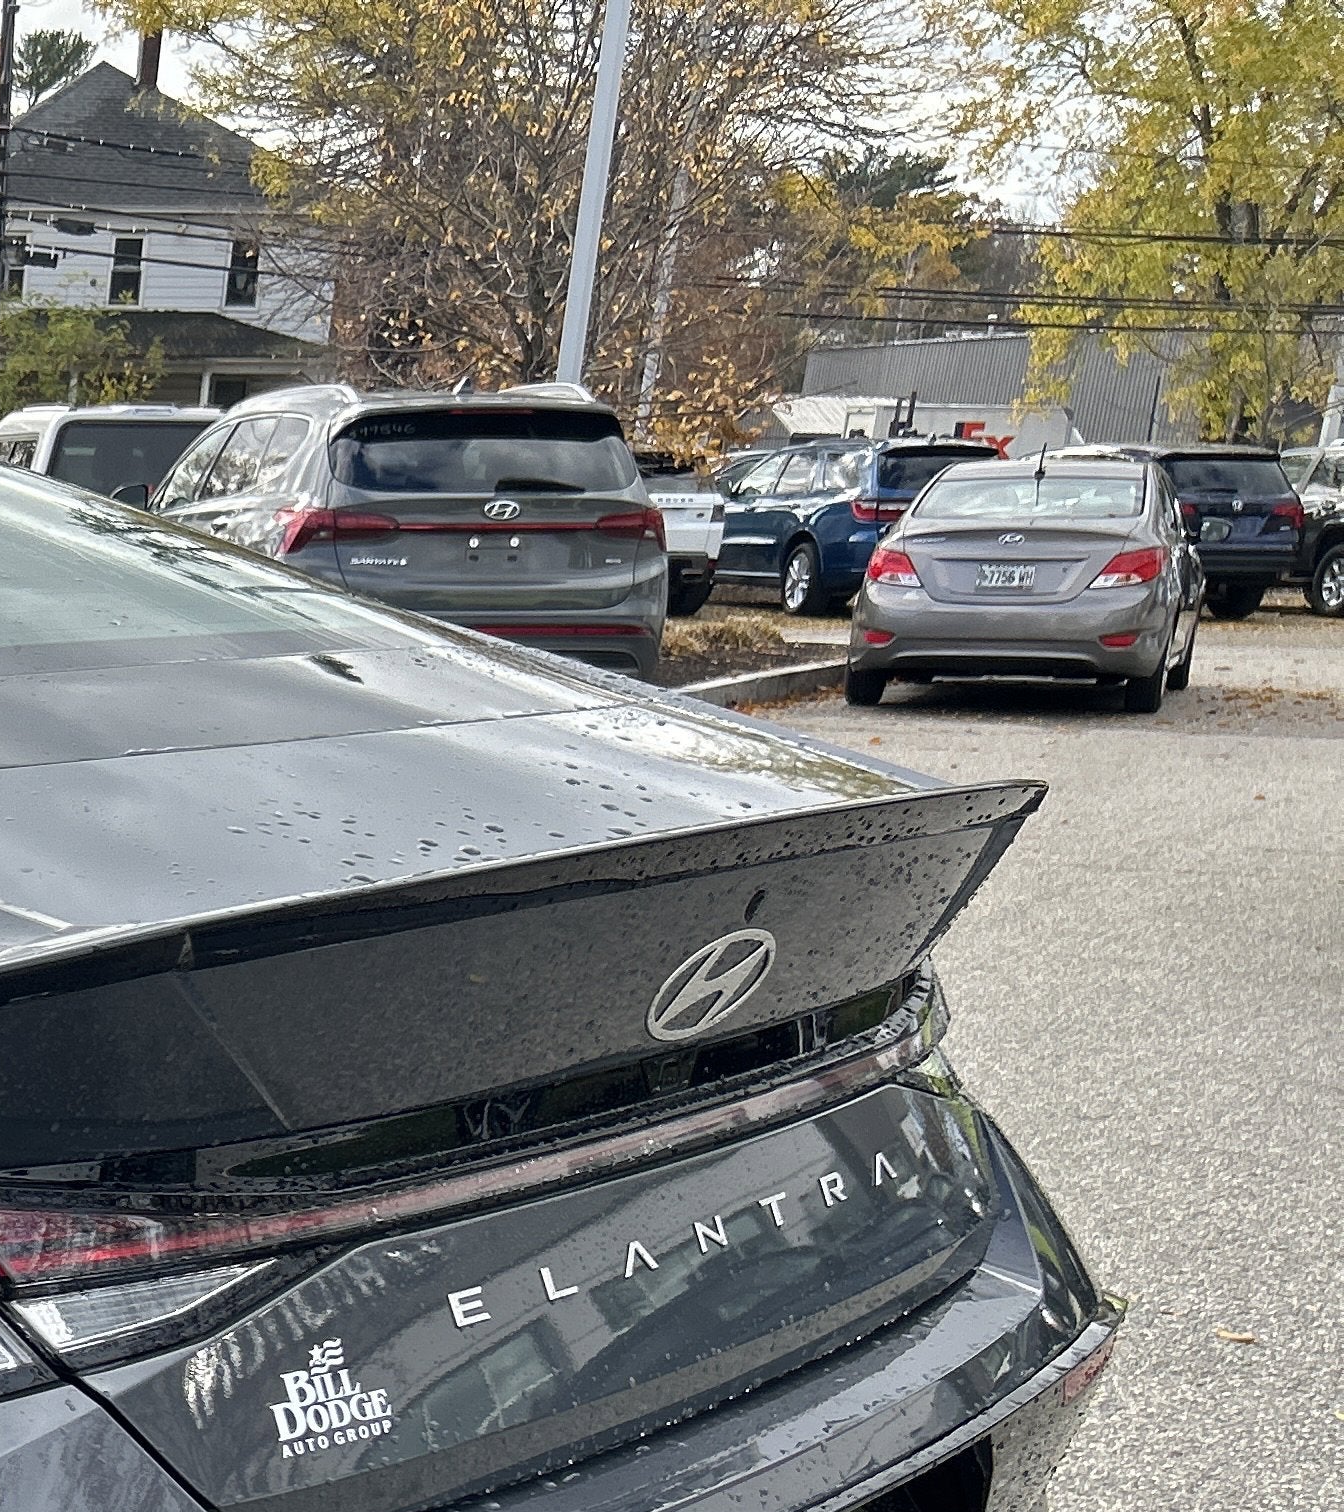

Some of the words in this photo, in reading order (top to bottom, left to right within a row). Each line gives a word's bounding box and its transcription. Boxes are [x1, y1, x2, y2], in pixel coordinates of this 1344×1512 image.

[448, 1152, 898, 1328] ELANTRA
[279, 1368, 361, 1407] BILL
[269, 1388, 392, 1442] DODGE
[282, 1435, 330, 1459] AUTO
[333, 1419, 393, 1445] GROUP
